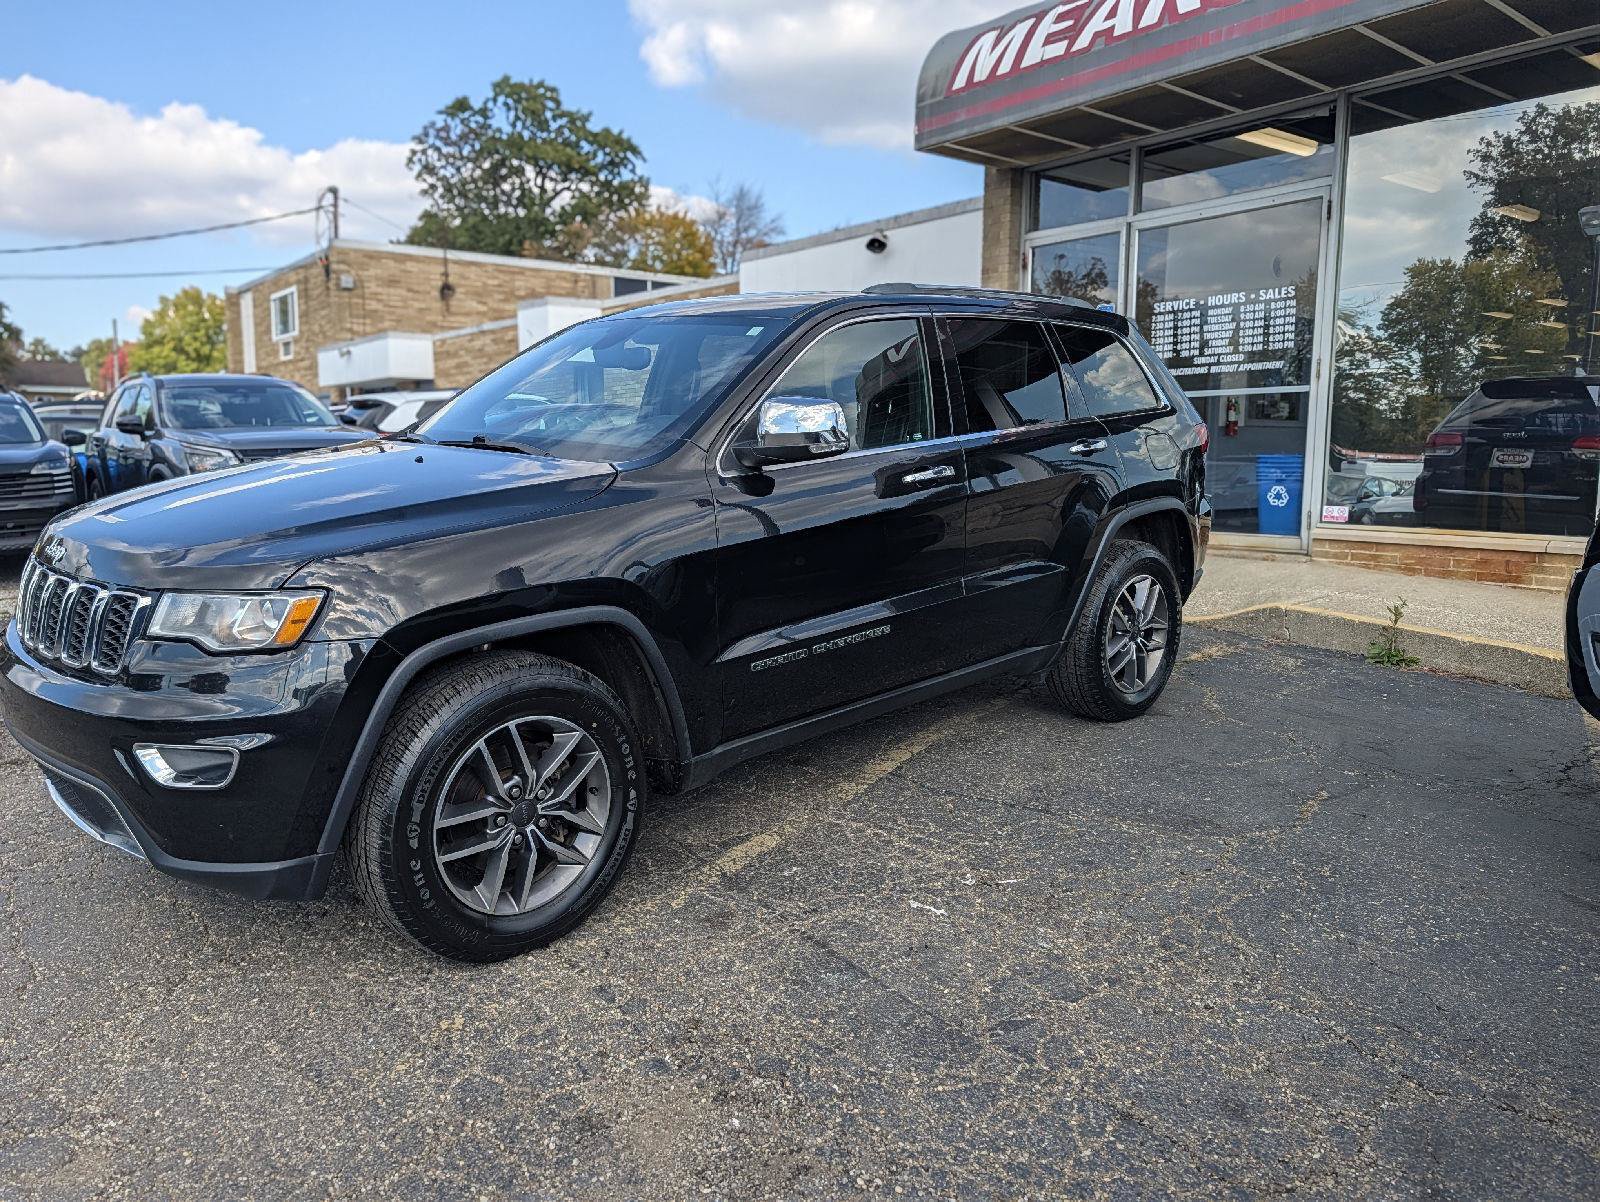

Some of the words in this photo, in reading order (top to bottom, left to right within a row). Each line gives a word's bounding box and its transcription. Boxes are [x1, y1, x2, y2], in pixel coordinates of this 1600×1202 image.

[1153, 298, 1196, 313] SERVICE
[1207, 292, 1246, 306] HOURS
[1259, 286, 1296, 300] SALES
[1191, 310, 1200, 318] PM
[1208, 306, 1233, 316] MONDAY
[1286, 299, 1296, 307] PM
[1207, 314, 1232, 324] TUESDAY
[1240, 312, 1254, 320] 9:00
[1254, 311, 1264, 319] AM
[1271, 309, 1284, 317] 6:00
[1286, 307, 1296, 315] PM
[1203, 321, 1236, 332] WEDNESDAY
[1254, 319, 1264, 327] AM
[1270, 317, 1284, 325] 6:00
[1285, 316, 1295, 324] PM
[1191, 333, 1200, 341] PM
[1203, 330, 1233, 340] THURSDAY
[1253, 327, 1263, 335] AM
[1285, 324, 1295, 332] PM
[1208, 338, 1229, 347] FRIDAY
[1239, 336, 1252, 344] 9:00
[1253, 335, 1263, 343] AM
[1284, 332, 1295, 340] PM
[1203, 345, 1233, 355] SATURDAY
[1253, 343, 1263, 351] AM
[1284, 340, 1294, 348] PM
[1193, 355, 1218, 365] SUNDAY
[1220, 353, 1244, 363] CLOSED
[1210, 364, 1238, 373] WITHOUT
[1238, 360, 1285, 371] APPOINTMENT
